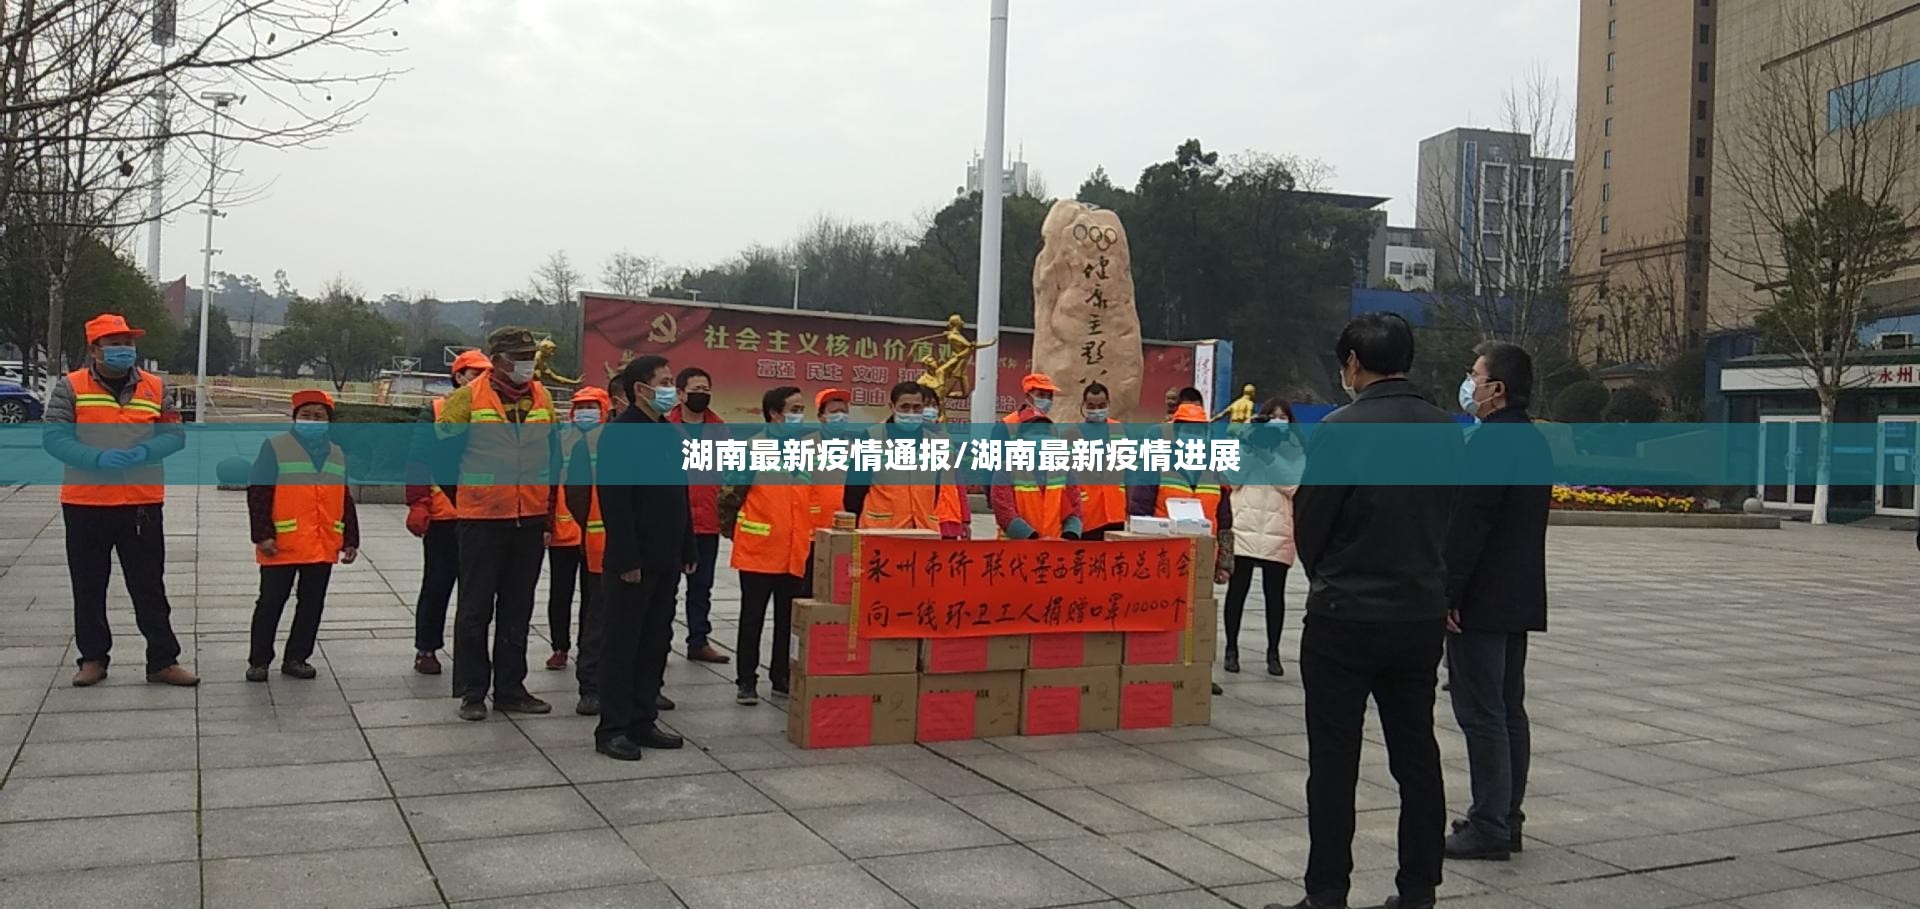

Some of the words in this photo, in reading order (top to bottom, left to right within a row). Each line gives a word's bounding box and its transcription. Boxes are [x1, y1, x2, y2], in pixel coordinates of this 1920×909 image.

[757, 359, 796, 379] 富强
[806, 362, 842, 381] 民主
[852, 365, 888, 383] 文明
[1879, 366, 1920, 384] 永州
[851, 387, 886, 406] 自由
